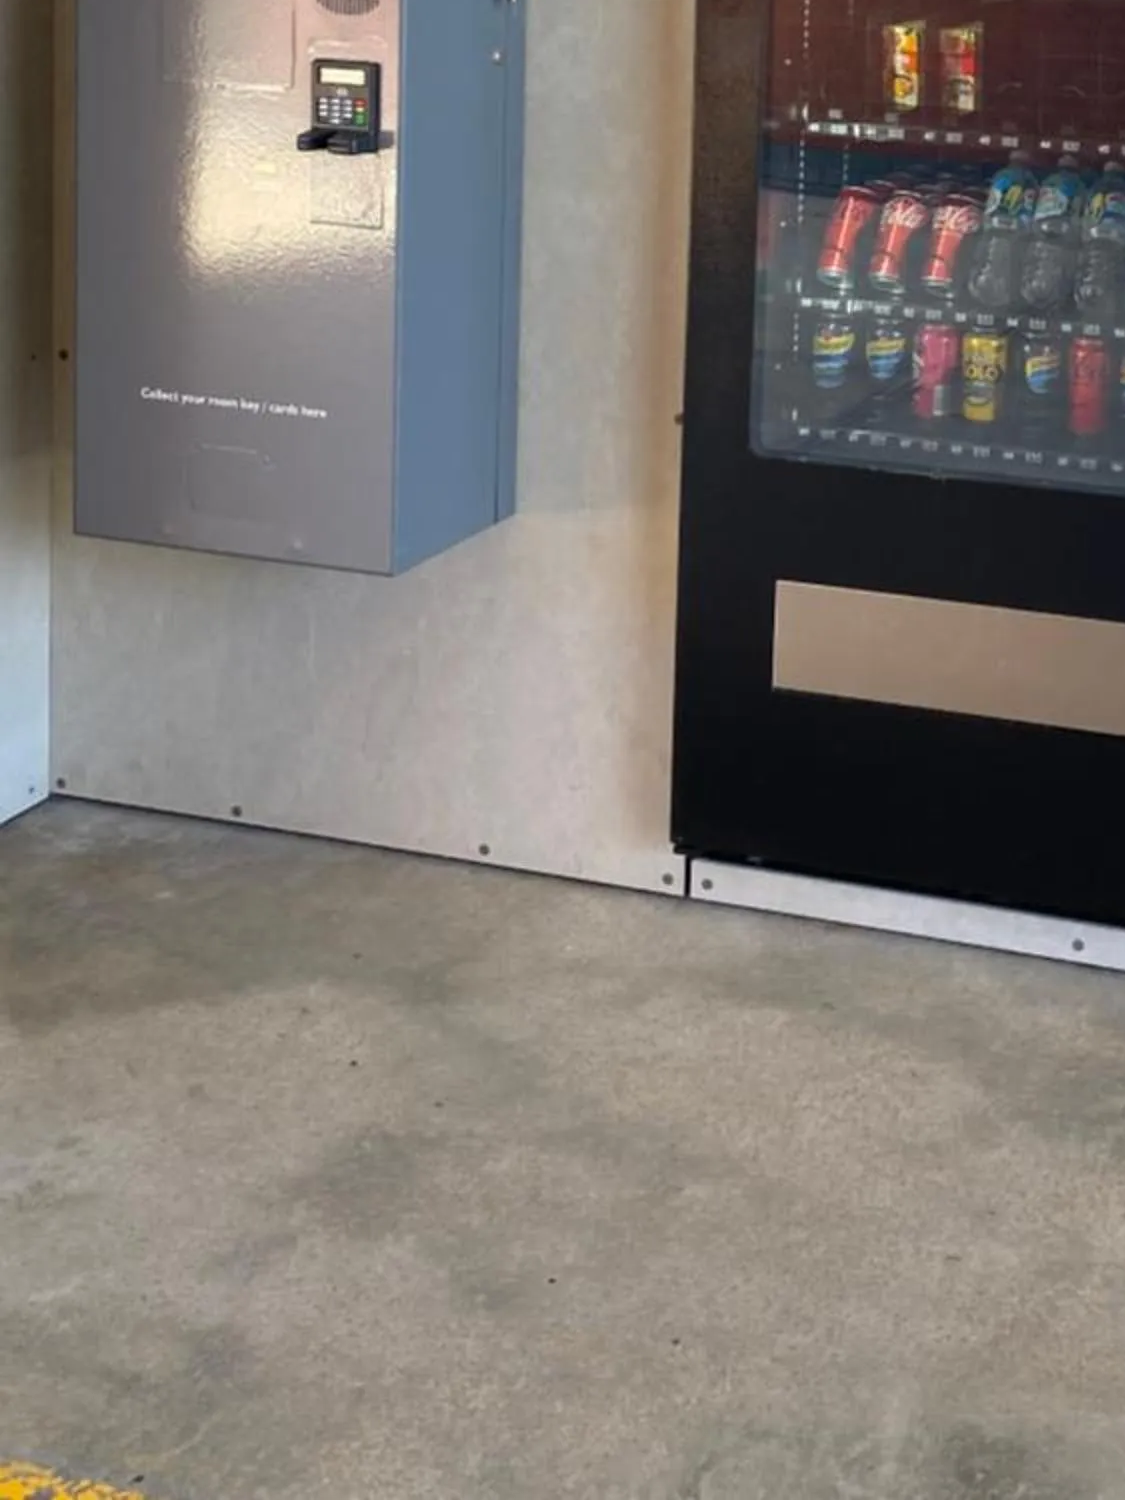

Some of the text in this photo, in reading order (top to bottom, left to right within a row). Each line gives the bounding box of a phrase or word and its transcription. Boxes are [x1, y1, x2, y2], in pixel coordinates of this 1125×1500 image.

[140, 386, 179, 403] Collect
[181, 393, 206, 405] your
[208, 397, 238, 408] room
[240, 398, 260, 414] key
[268, 403, 299, 416] cards
[301, 406, 328, 419] here
